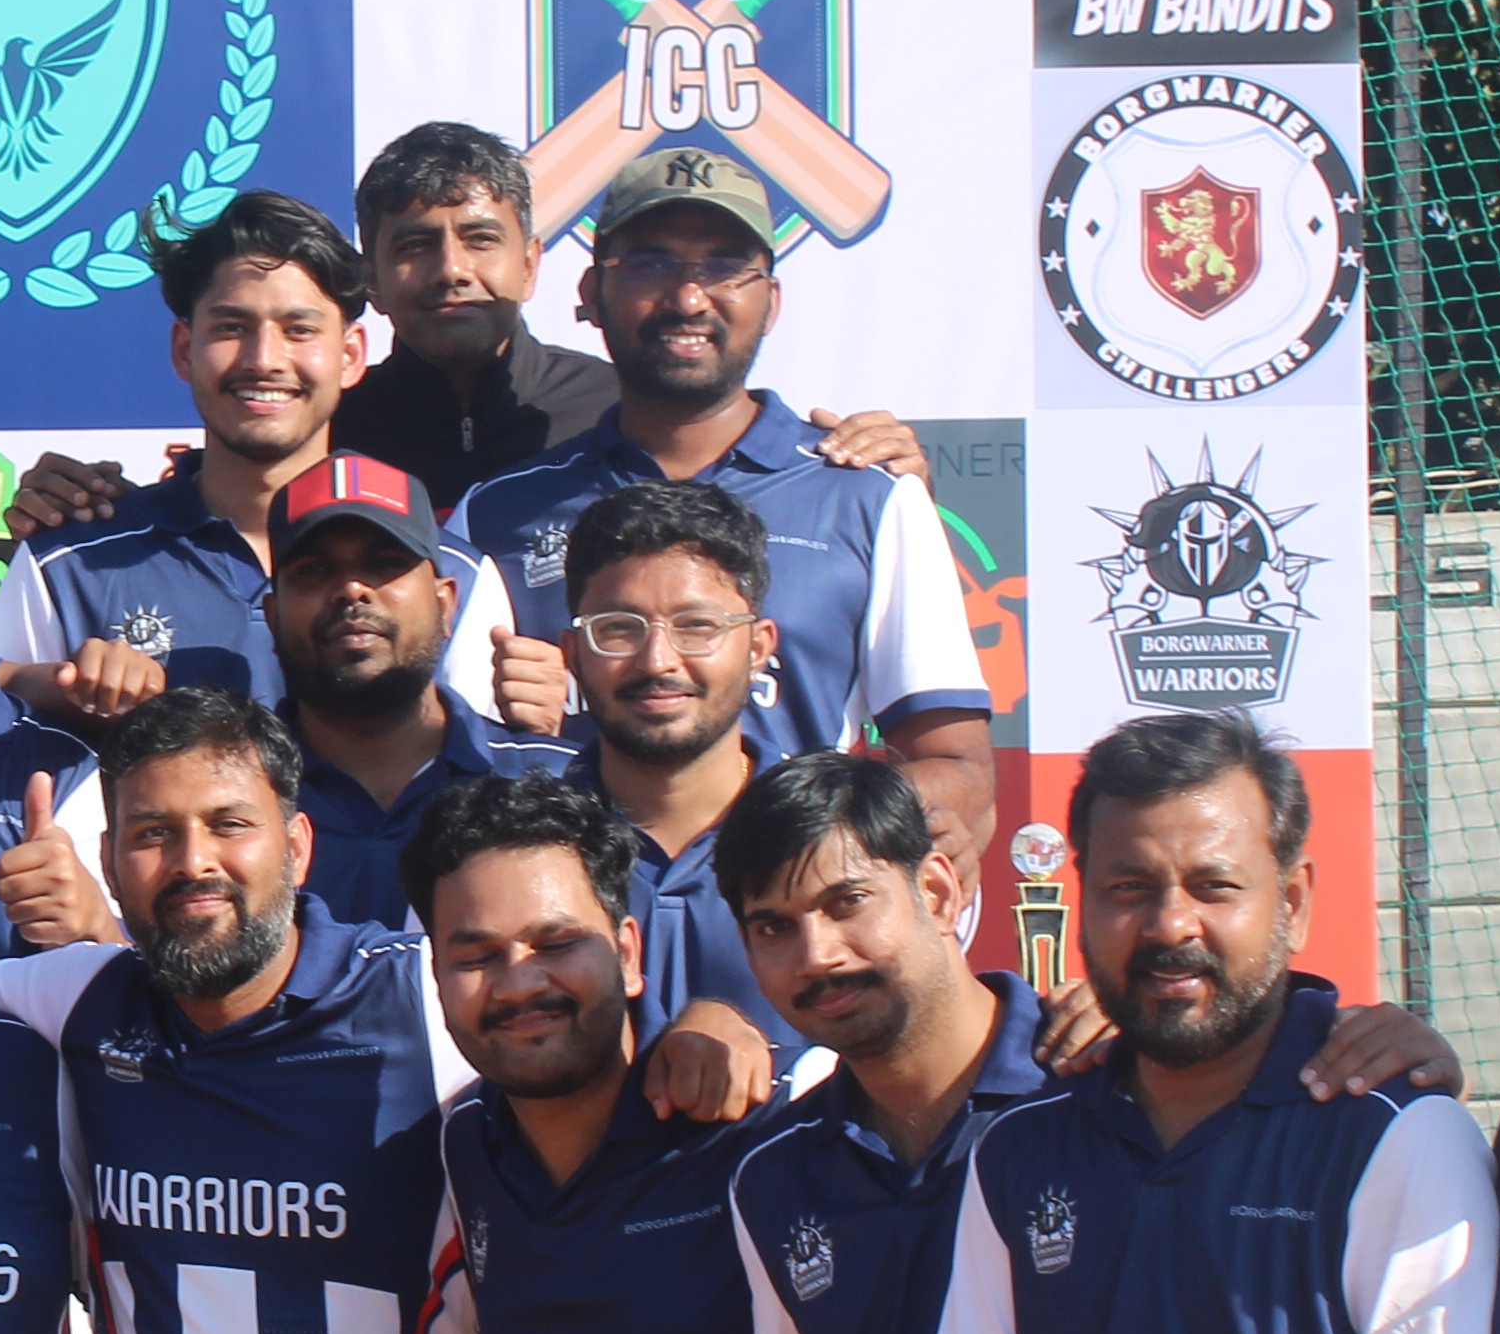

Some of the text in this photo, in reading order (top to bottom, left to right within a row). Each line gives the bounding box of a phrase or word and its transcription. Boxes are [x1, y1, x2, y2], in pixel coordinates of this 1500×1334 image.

[619, 24, 762, 133] ICC
[1072, 75, 1328, 164] BORGWARNER
[1096, 339, 1312, 400] CHALLENGERS
[1141, 634, 1269, 652] BORGWARNER
[1134, 667, 1278, 691] WARRIORS
[95, 1164, 348, 1240] WARRIORS
